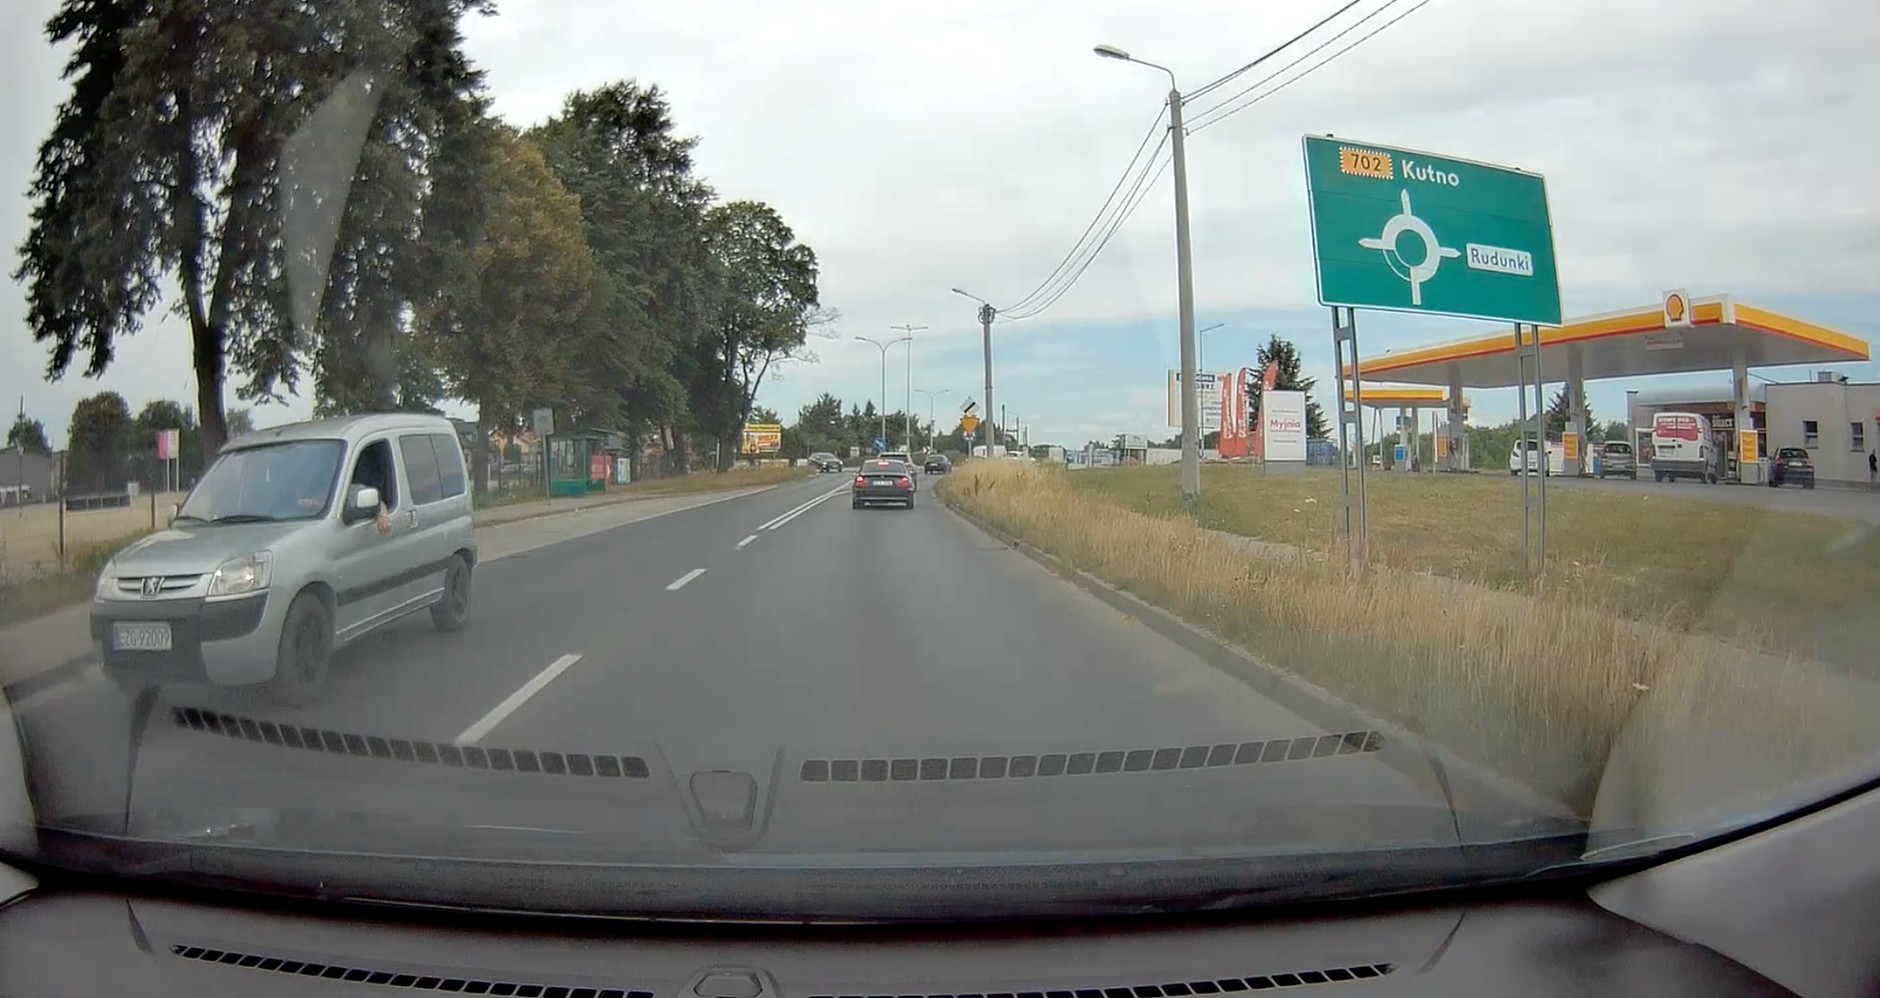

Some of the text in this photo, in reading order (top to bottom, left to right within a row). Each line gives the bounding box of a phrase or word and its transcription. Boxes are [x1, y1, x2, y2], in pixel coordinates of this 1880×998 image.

[1350, 152, 1460, 188] 702 Kutno
[1470, 247, 1531, 271] Rudunki
[1269, 419, 1301, 430] Myjnia
